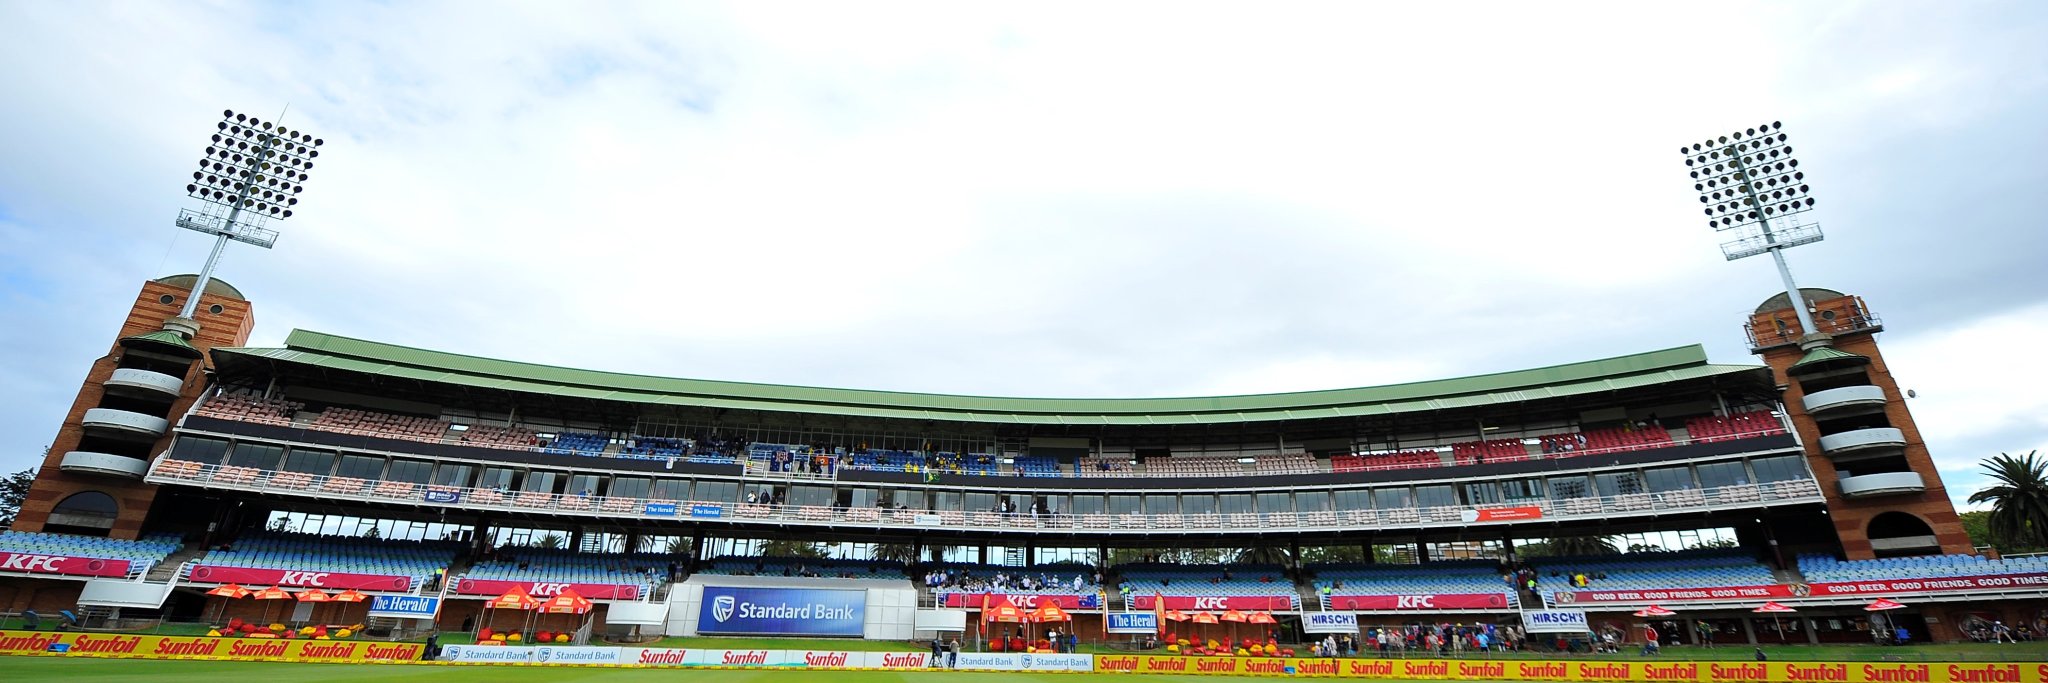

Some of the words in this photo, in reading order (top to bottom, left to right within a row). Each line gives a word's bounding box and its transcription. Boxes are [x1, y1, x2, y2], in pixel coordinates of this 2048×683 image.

[0, 553, 68, 571] KFC
[279, 571, 330, 586] KFC
[1828, 584, 1857, 593] GOOD
[1858, 583, 1889, 592] BEER.
[1892, 582, 1921, 591] GOOD
[1923, 580, 1976, 589] FRIENDS.
[1977, 578, 2011, 587] GOOD
[529, 582, 570, 596] KFC
[1592, 592, 1616, 600] GOOD
[1644, 591, 1668, 600] GOOD
[1670, 590, 1711, 599] FRIENDS.
[1711, 589, 1737, 598] GOOD
[1739, 588, 1770, 597] TIMES.
[372, 596, 388, 610] The
[389, 597, 430, 612] Herald
[1006, 595, 1038, 607] KFC
[1194, 597, 1228, 609] KFC
[1397, 596, 1434, 608] KFC
[739, 602, 811, 619] Standard
[814, 604, 854, 620] Bank
[1532, 612, 1584, 623] HIRSCH'S
[1113, 615, 1129, 627] The
[1131, 615, 1156, 627] Herald
[1312, 614, 1355, 625] HIRSCH'S
[71, 634, 142, 653] Sunfoil
[154, 637, 220, 655] Sunfoil
[228, 639, 290, 657] Sunfoil
[299, 641, 357, 658] Sunfoil
[363, 643, 420, 660] Sunfoil
[465, 650, 505, 659] Standard
[506, 651, 528, 660] Bank
[555, 651, 594, 660] Standard
[595, 652, 616, 660] Bank
[639, 649, 686, 664] Sunfoil
[722, 651, 768, 664] Sunfoil
[805, 652, 847, 666] Sunfoil
[883, 653, 925, 667] Sunfoil
[961, 657, 994, 666] Standard
[995, 657, 1013, 666] Bank
[1036, 658, 1069, 666] Standard
[1071, 658, 1088, 666] Bank
[1100, 656, 1138, 671] Sunfoil
[1148, 656, 1187, 671] Sunfoil
[1197, 657, 1236, 672] Sunfoil
[1245, 658, 1285, 673] Sunfoil
[1298, 660, 1341, 674] Sunfoil
[1351, 660, 1393, 675] Sunfoil
[1405, 661, 1448, 676] Sunfoil
[1459, 661, 1505, 677] Sunfoil
[1519, 663, 1567, 678] Sunfoil
[1579, 663, 1630, 679] Sunfoil
[1644, 663, 1698, 679] Sunfoil
[1711, 663, 1767, 680] Sunfoil
[1786, 663, 1847, 681] Sunfoil
[1863, 664, 1930, 682] Sunfoil
[1948, 664, 2020, 683] Sunfoil
